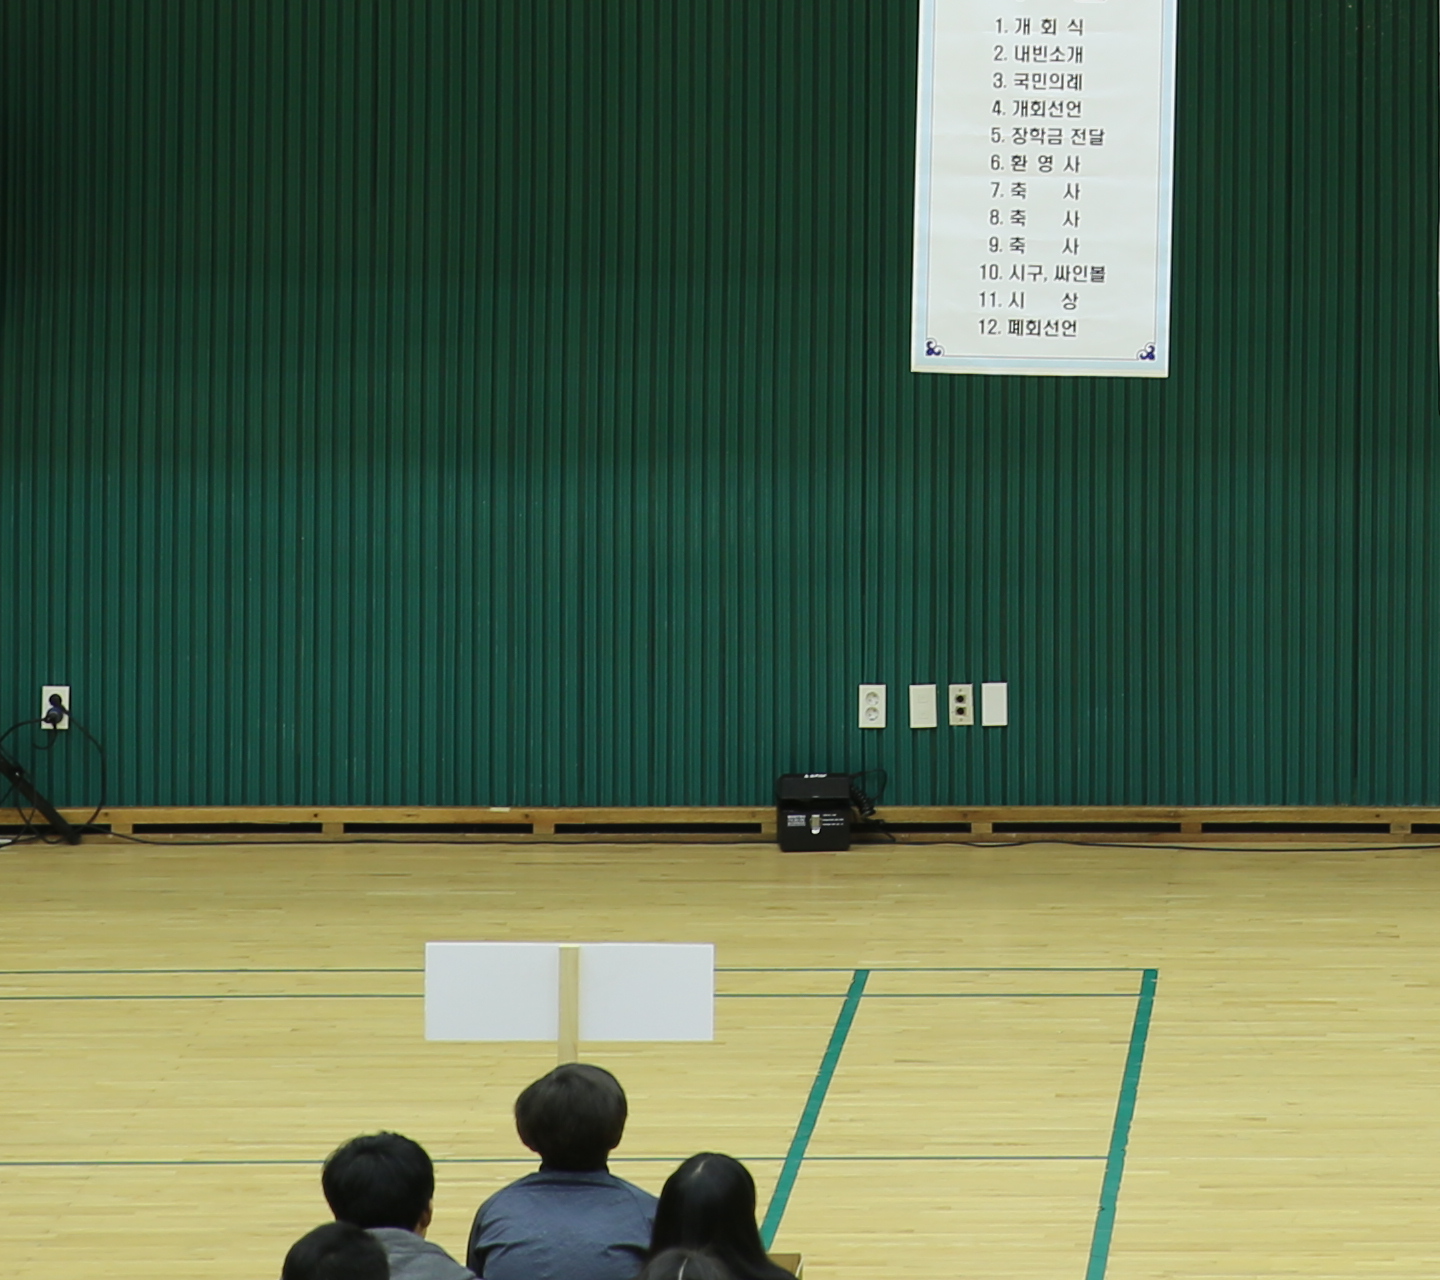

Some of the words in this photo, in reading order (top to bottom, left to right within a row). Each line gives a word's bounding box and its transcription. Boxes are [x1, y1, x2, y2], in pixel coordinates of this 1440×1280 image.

[997, 18, 1008, 33] 1.
[994, 45, 1007, 61] 2.
[1015, 46, 1082, 63] 내빈소개
[993, 73, 1006, 88] 3.
[1015, 73, 1082, 90] 국민의례
[993, 100, 1007, 115] 4.
[1014, 101, 1080, 117] 개회선언
[992, 127, 1004, 143] 5.
[1013, 128, 1062, 145] 장학금
[1072, 129, 1104, 145] 전달
[991, 155, 1003, 170] 6.
[992, 182, 1003, 197] 7.
[990, 209, 1002, 225] 8.
[990, 237, 1002, 252] 9.
[981, 264, 1001, 279] 10.
[1010, 265, 1047, 281] 시구,
[1055, 266, 1105, 282] 싸인볼
[980, 292, 1001, 307] 11.
[980, 319, 1000, 334] 12.
[1009, 320, 1076, 336] 폐회선언
